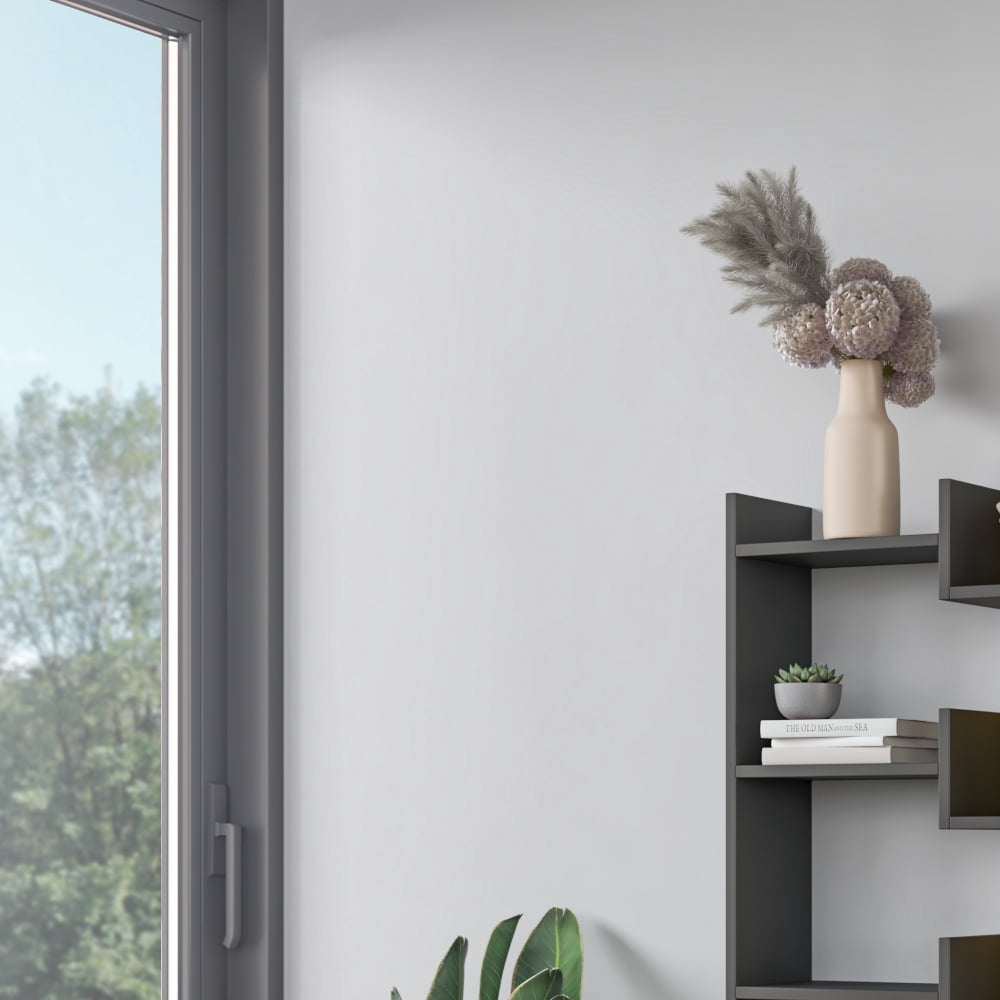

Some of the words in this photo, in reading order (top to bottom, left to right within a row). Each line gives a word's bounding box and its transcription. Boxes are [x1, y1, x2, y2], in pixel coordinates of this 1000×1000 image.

[785, 724, 800, 733] THE
[801, 724, 816, 732] OLD
[817, 723, 833, 732] MAN
[854, 723, 869, 732] SEA
